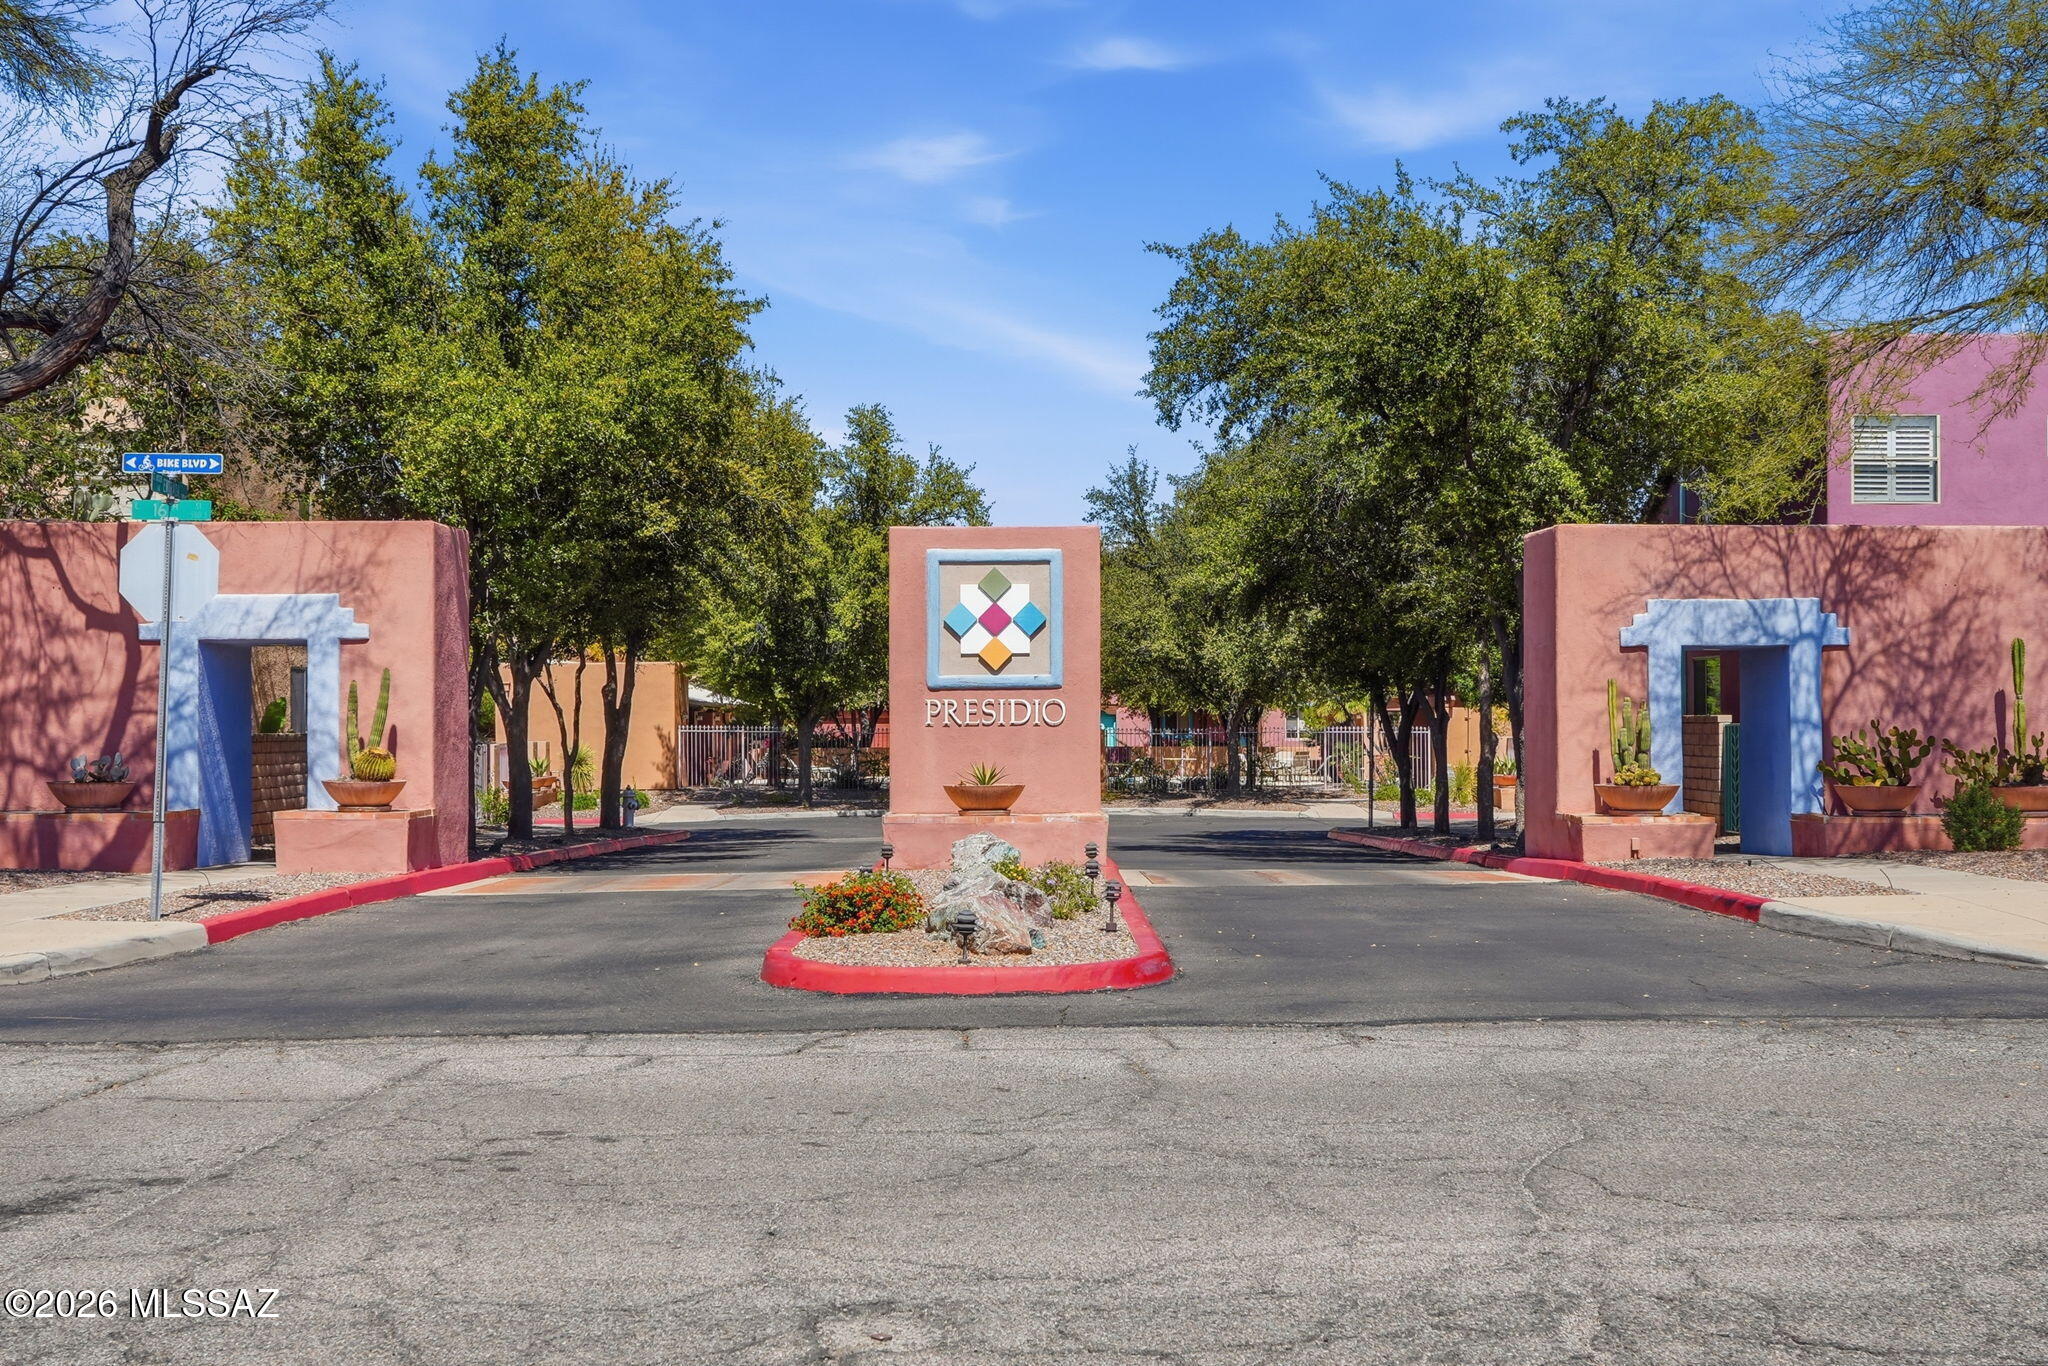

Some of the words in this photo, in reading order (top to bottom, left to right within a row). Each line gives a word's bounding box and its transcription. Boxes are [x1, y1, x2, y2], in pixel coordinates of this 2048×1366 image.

[156, 458, 180, 468] BIKE
[181, 458, 208, 469] BLVD
[924, 697, 1067, 728] PRESIDIO
